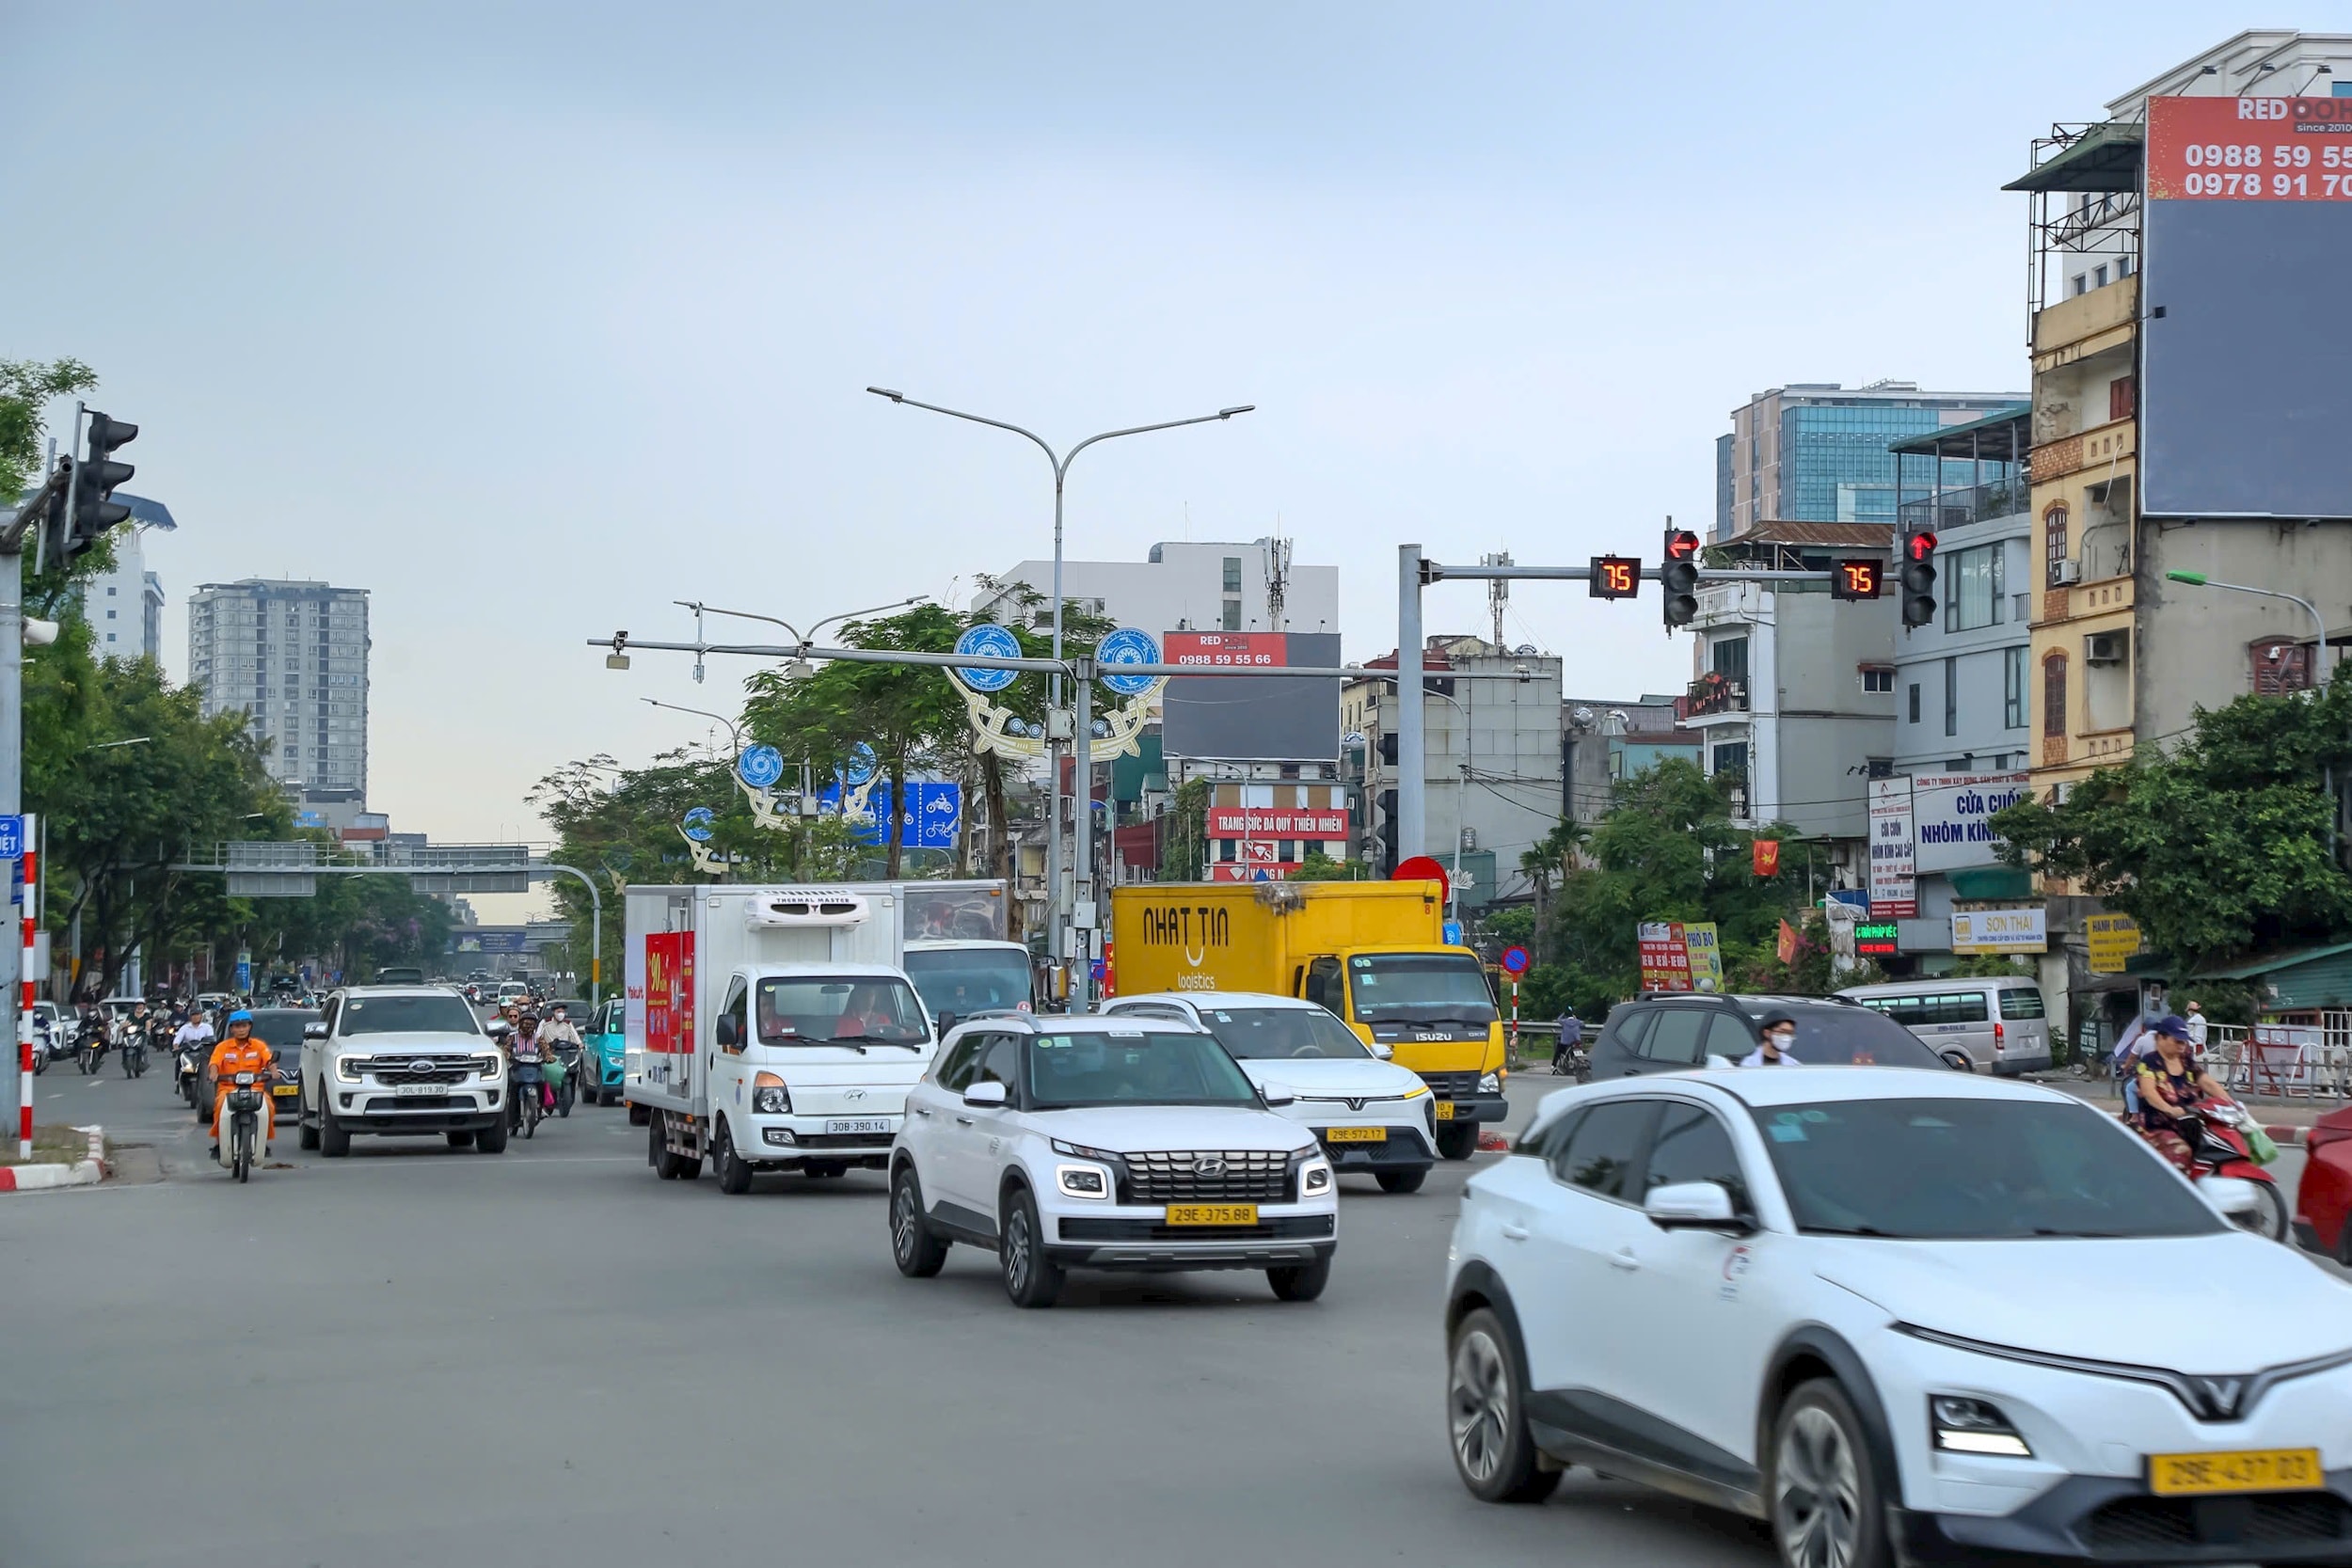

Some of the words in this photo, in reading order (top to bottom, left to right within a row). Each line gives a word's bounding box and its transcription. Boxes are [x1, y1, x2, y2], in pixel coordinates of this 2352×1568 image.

[2238, 99, 2288, 119] RED
[2296, 123, 2326, 133] since
[2328, 123, 2352, 133] 2010
[2185, 145, 2262, 167] 0988
[2273, 146, 2311, 167] 59
[2185, 173, 2262, 195] 0978
[2273, 174, 2307, 196] 91
[1602, 564, 1630, 591] 75
[1843, 566, 1871, 593] 75
[1200, 636, 1221, 645] RED
[1179, 655, 1211, 664] 0988
[1216, 655, 1231, 664] 59
[1235, 655, 1251, 664] 55
[1255, 655, 1271, 664] 66
[1957, 790, 1984, 815] CỬA
[1218, 816, 1244, 831] TRANG
[1263, 814, 1275, 832] ĐÁ
[1276, 814, 1292, 832] QUÝ
[1294, 814, 1315, 832] THIÊN
[1318, 815, 1343, 832] NHIÊN
[1921, 820, 1963, 843] NHÔM
[1178, 972, 1215, 990] logistics
[1415, 1033, 1453, 1041] ISUZU
[833, 1121, 884, 1132] 30B-390.14
[1175, 1209, 1249, 1221] 29E-375.88
